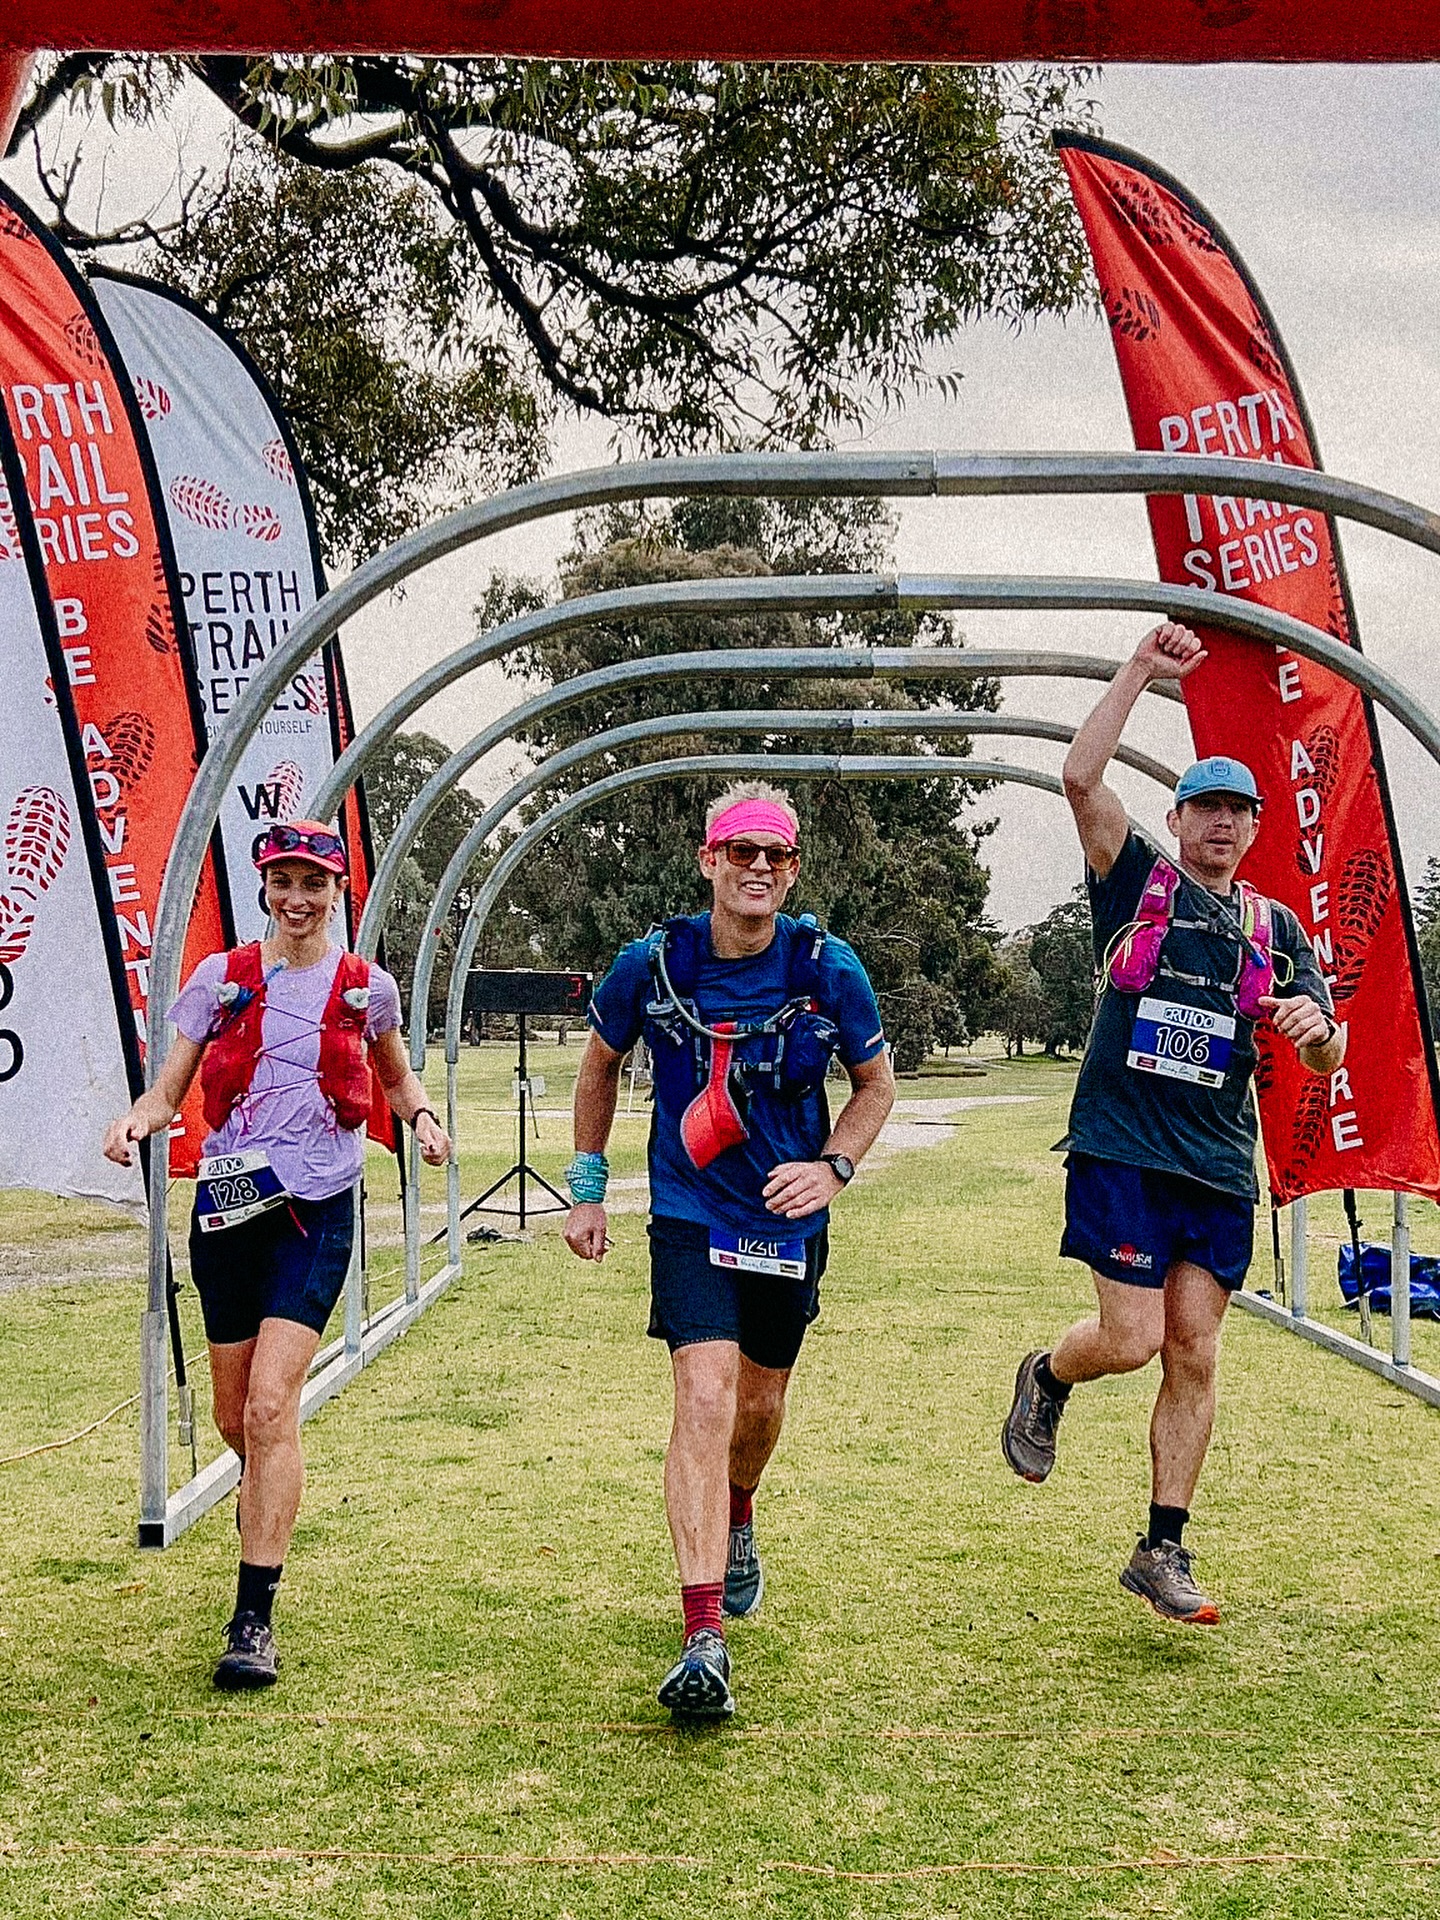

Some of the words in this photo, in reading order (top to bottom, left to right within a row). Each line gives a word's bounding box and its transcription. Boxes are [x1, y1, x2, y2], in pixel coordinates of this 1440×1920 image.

[1, 380, 114, 439] RTH
[1159, 388, 1296, 457] PERTH
[18, 442, 129, 512] AIL
[34, 509, 140, 566] RIES
[1184, 517, 1318, 591] SERIES
[179, 571, 301, 614] PERTH
[1156, 1026, 1209, 1064] 106
[208, 1177, 259, 1210] 128
